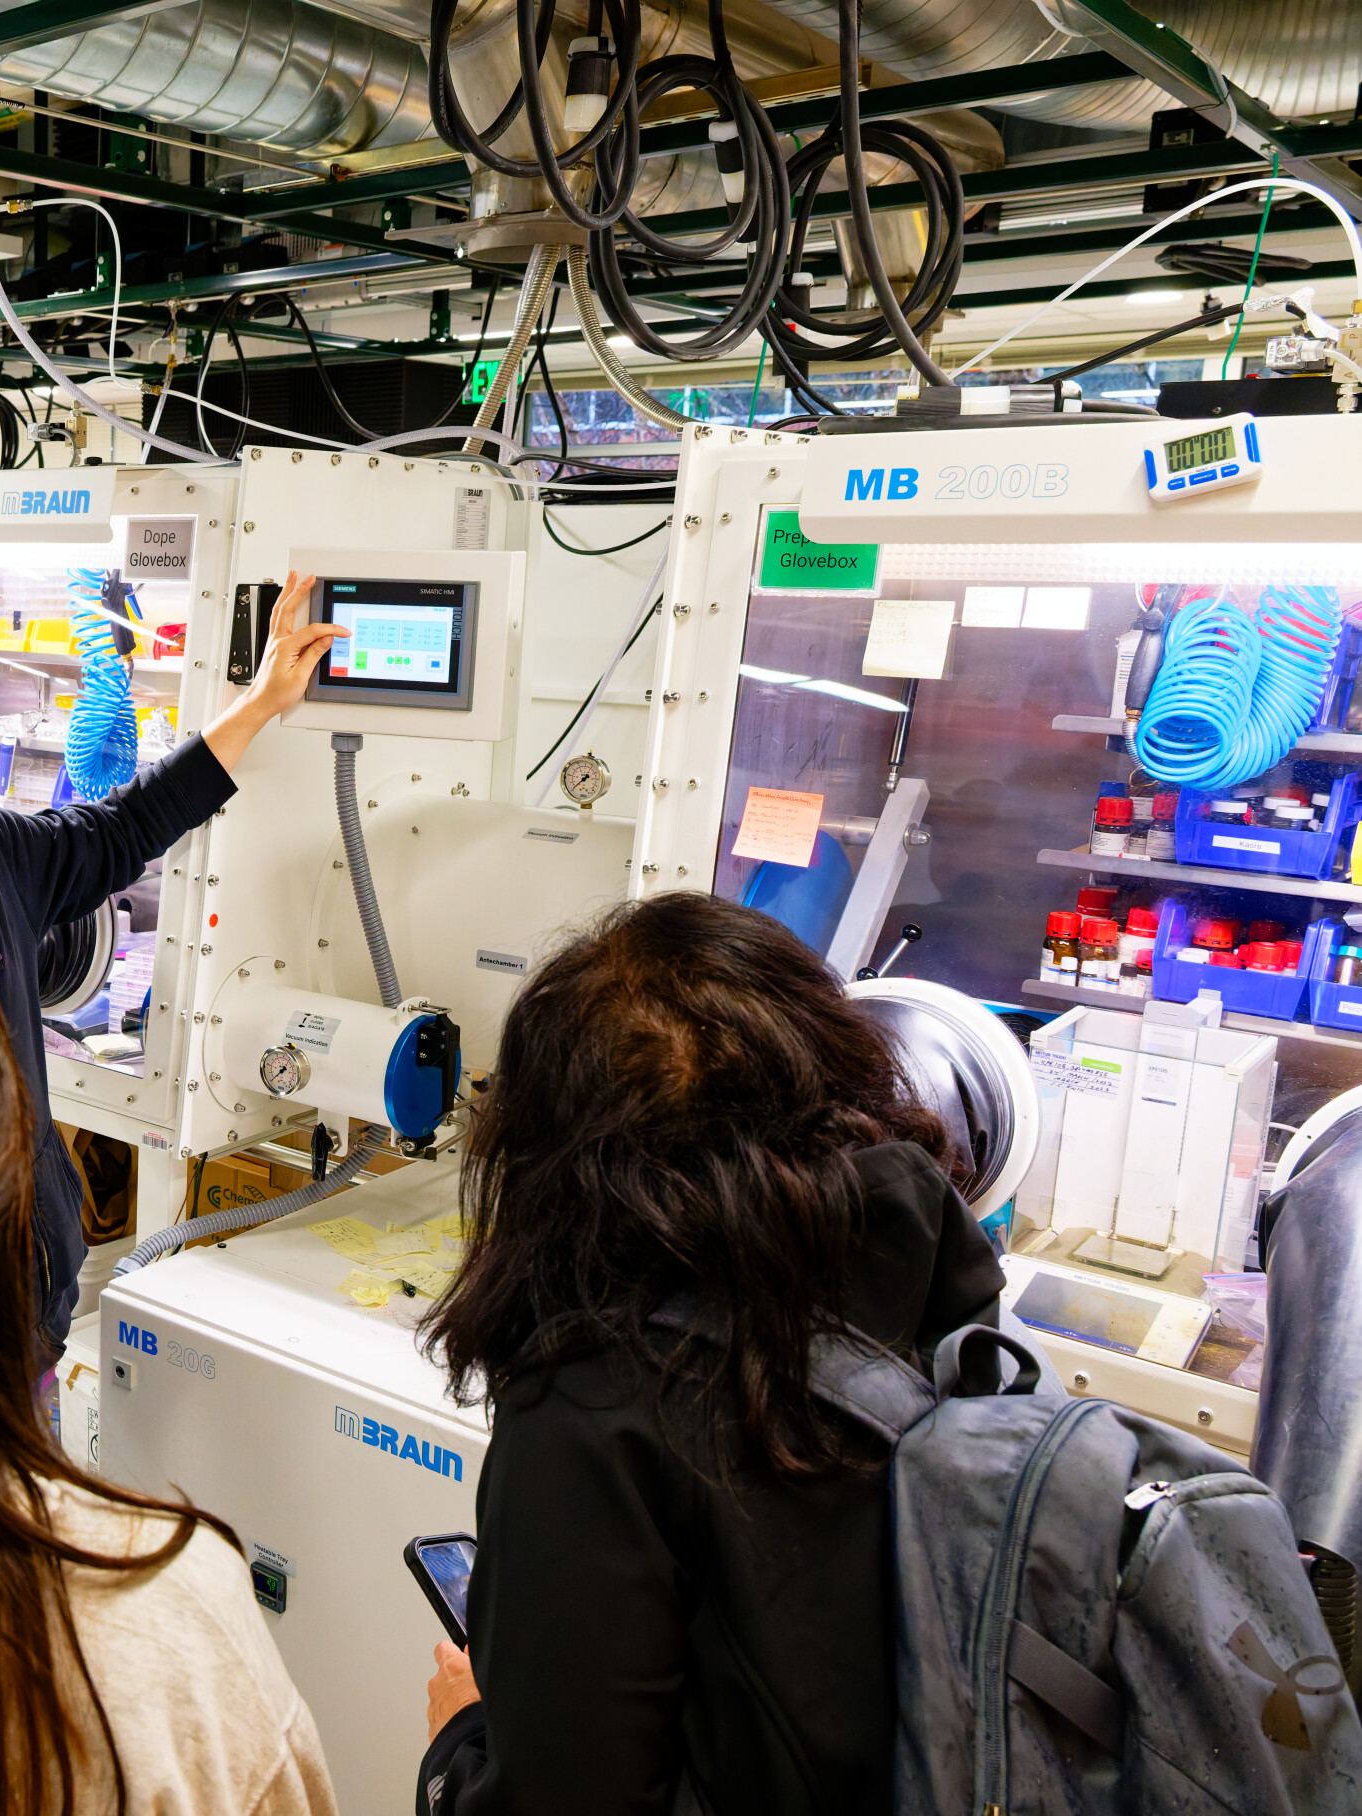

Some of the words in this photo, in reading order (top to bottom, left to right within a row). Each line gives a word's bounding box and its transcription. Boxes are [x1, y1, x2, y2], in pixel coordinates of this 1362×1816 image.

[844, 468, 919, 500] MB
[935, 463, 1070, 499] 200B
[143, 529, 176, 547] Dope
[773, 529, 816, 548] Prep
[129, 552, 187, 568] Glovebox
[780, 552, 858, 569] Glovebox
[452, 608, 463, 640] TOUCH
[478, 956, 519, 968] Antechamber
[285, 1032, 304, 1042] Vacuum
[119, 1320, 158, 1356] MB
[166, 1340, 217, 1380] 20G
[254, 1542, 277, 1558] Heatable
[277, 1553, 289, 1565] Tray
[258, 1552, 284, 1569] Controller
